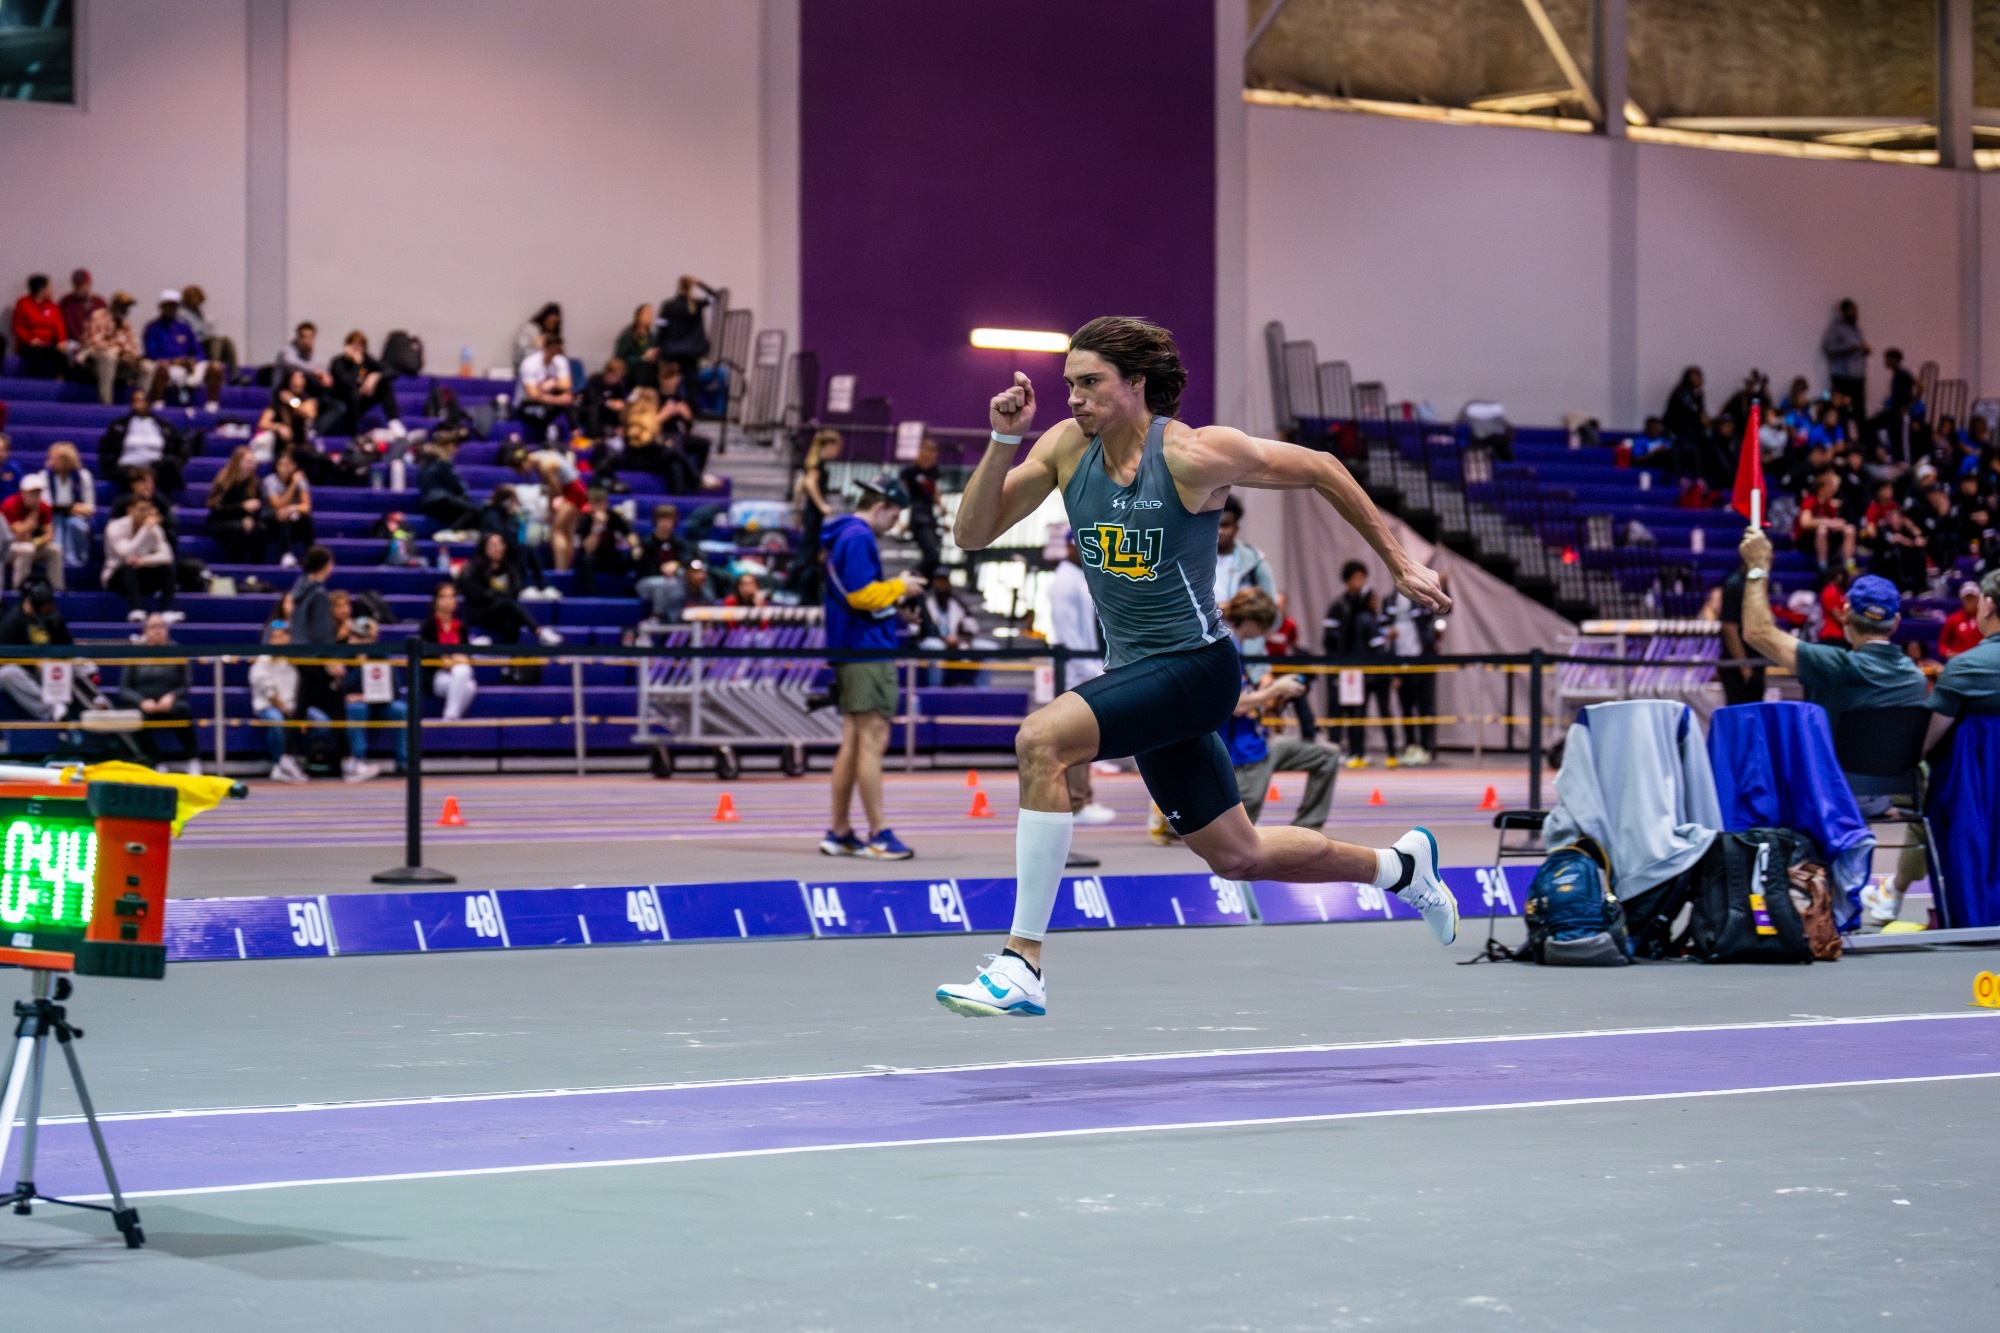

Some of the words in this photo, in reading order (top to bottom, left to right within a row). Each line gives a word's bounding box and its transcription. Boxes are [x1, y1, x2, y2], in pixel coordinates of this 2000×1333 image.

[626, 890, 660, 932] 46
[812, 887, 847, 926] 44
[928, 883, 962, 923] 42
[1073, 879, 1105, 918] 40
[1209, 875, 1243, 914] 38
[288, 902, 325, 946] 50
[465, 895, 499, 937] 48
